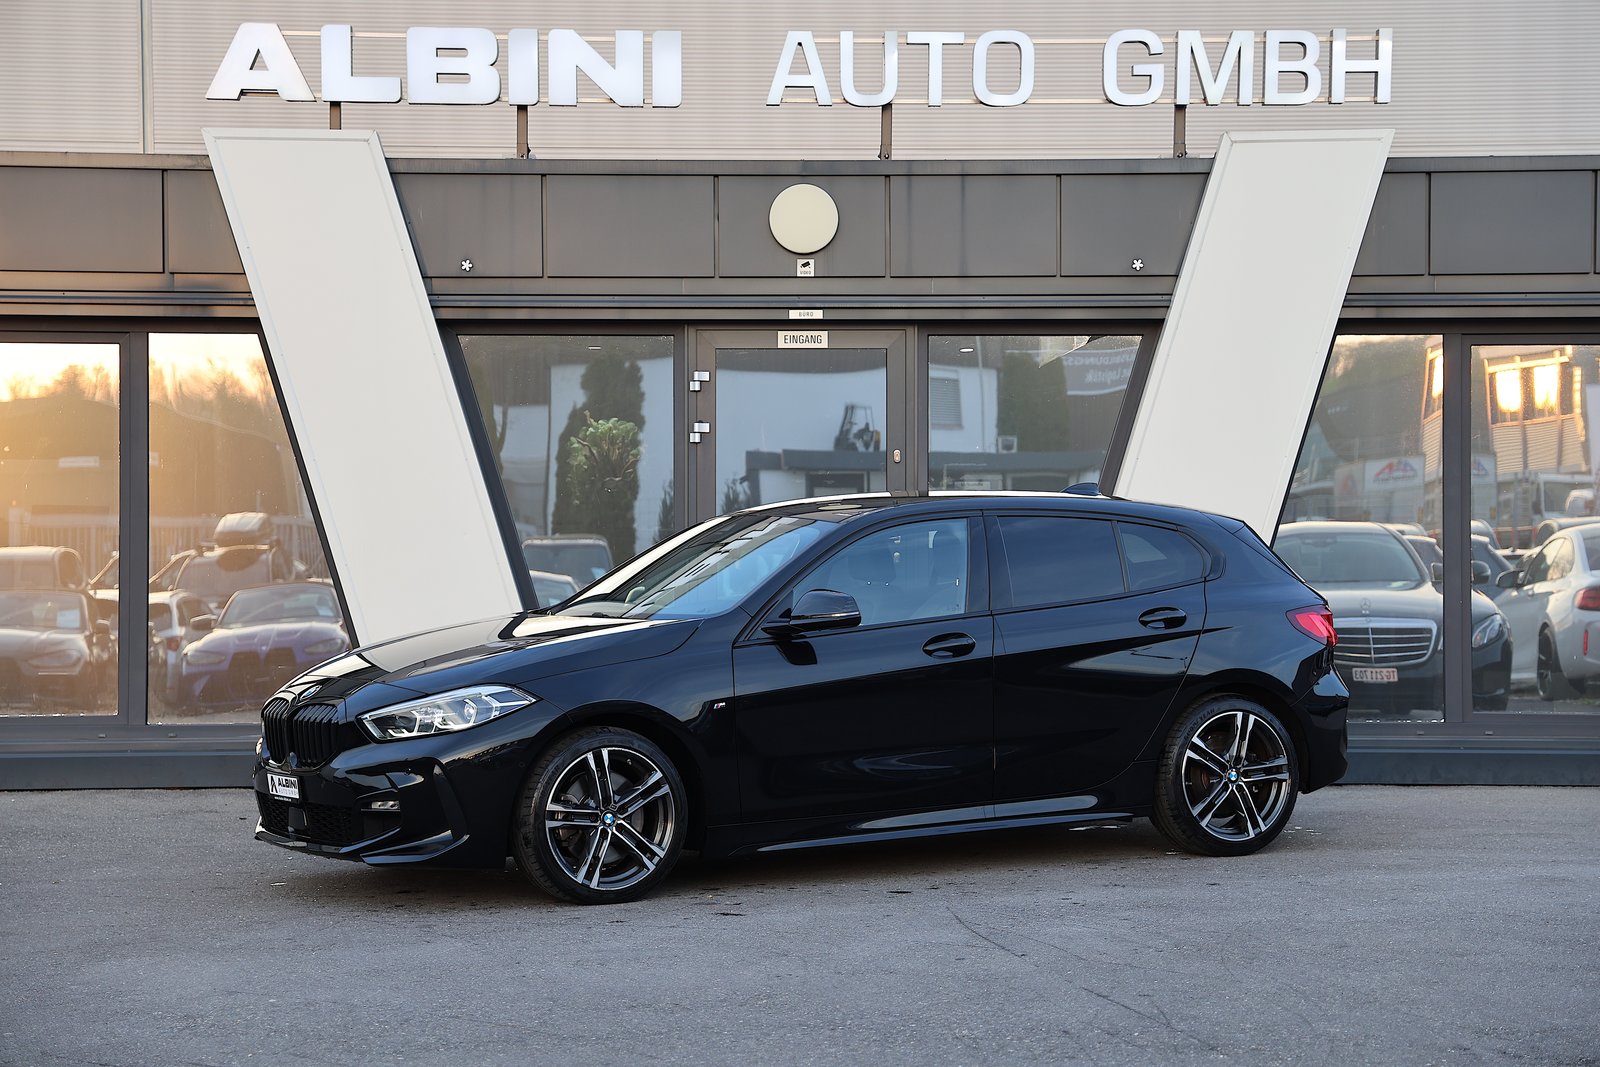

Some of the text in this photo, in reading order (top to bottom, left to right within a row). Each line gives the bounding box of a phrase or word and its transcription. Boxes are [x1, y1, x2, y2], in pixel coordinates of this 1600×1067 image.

[205, 22, 1393, 108] ALBINI AUTO GMBH
[784, 334, 823, 344] EINGANG
[278, 777, 298, 790] ALBINI
